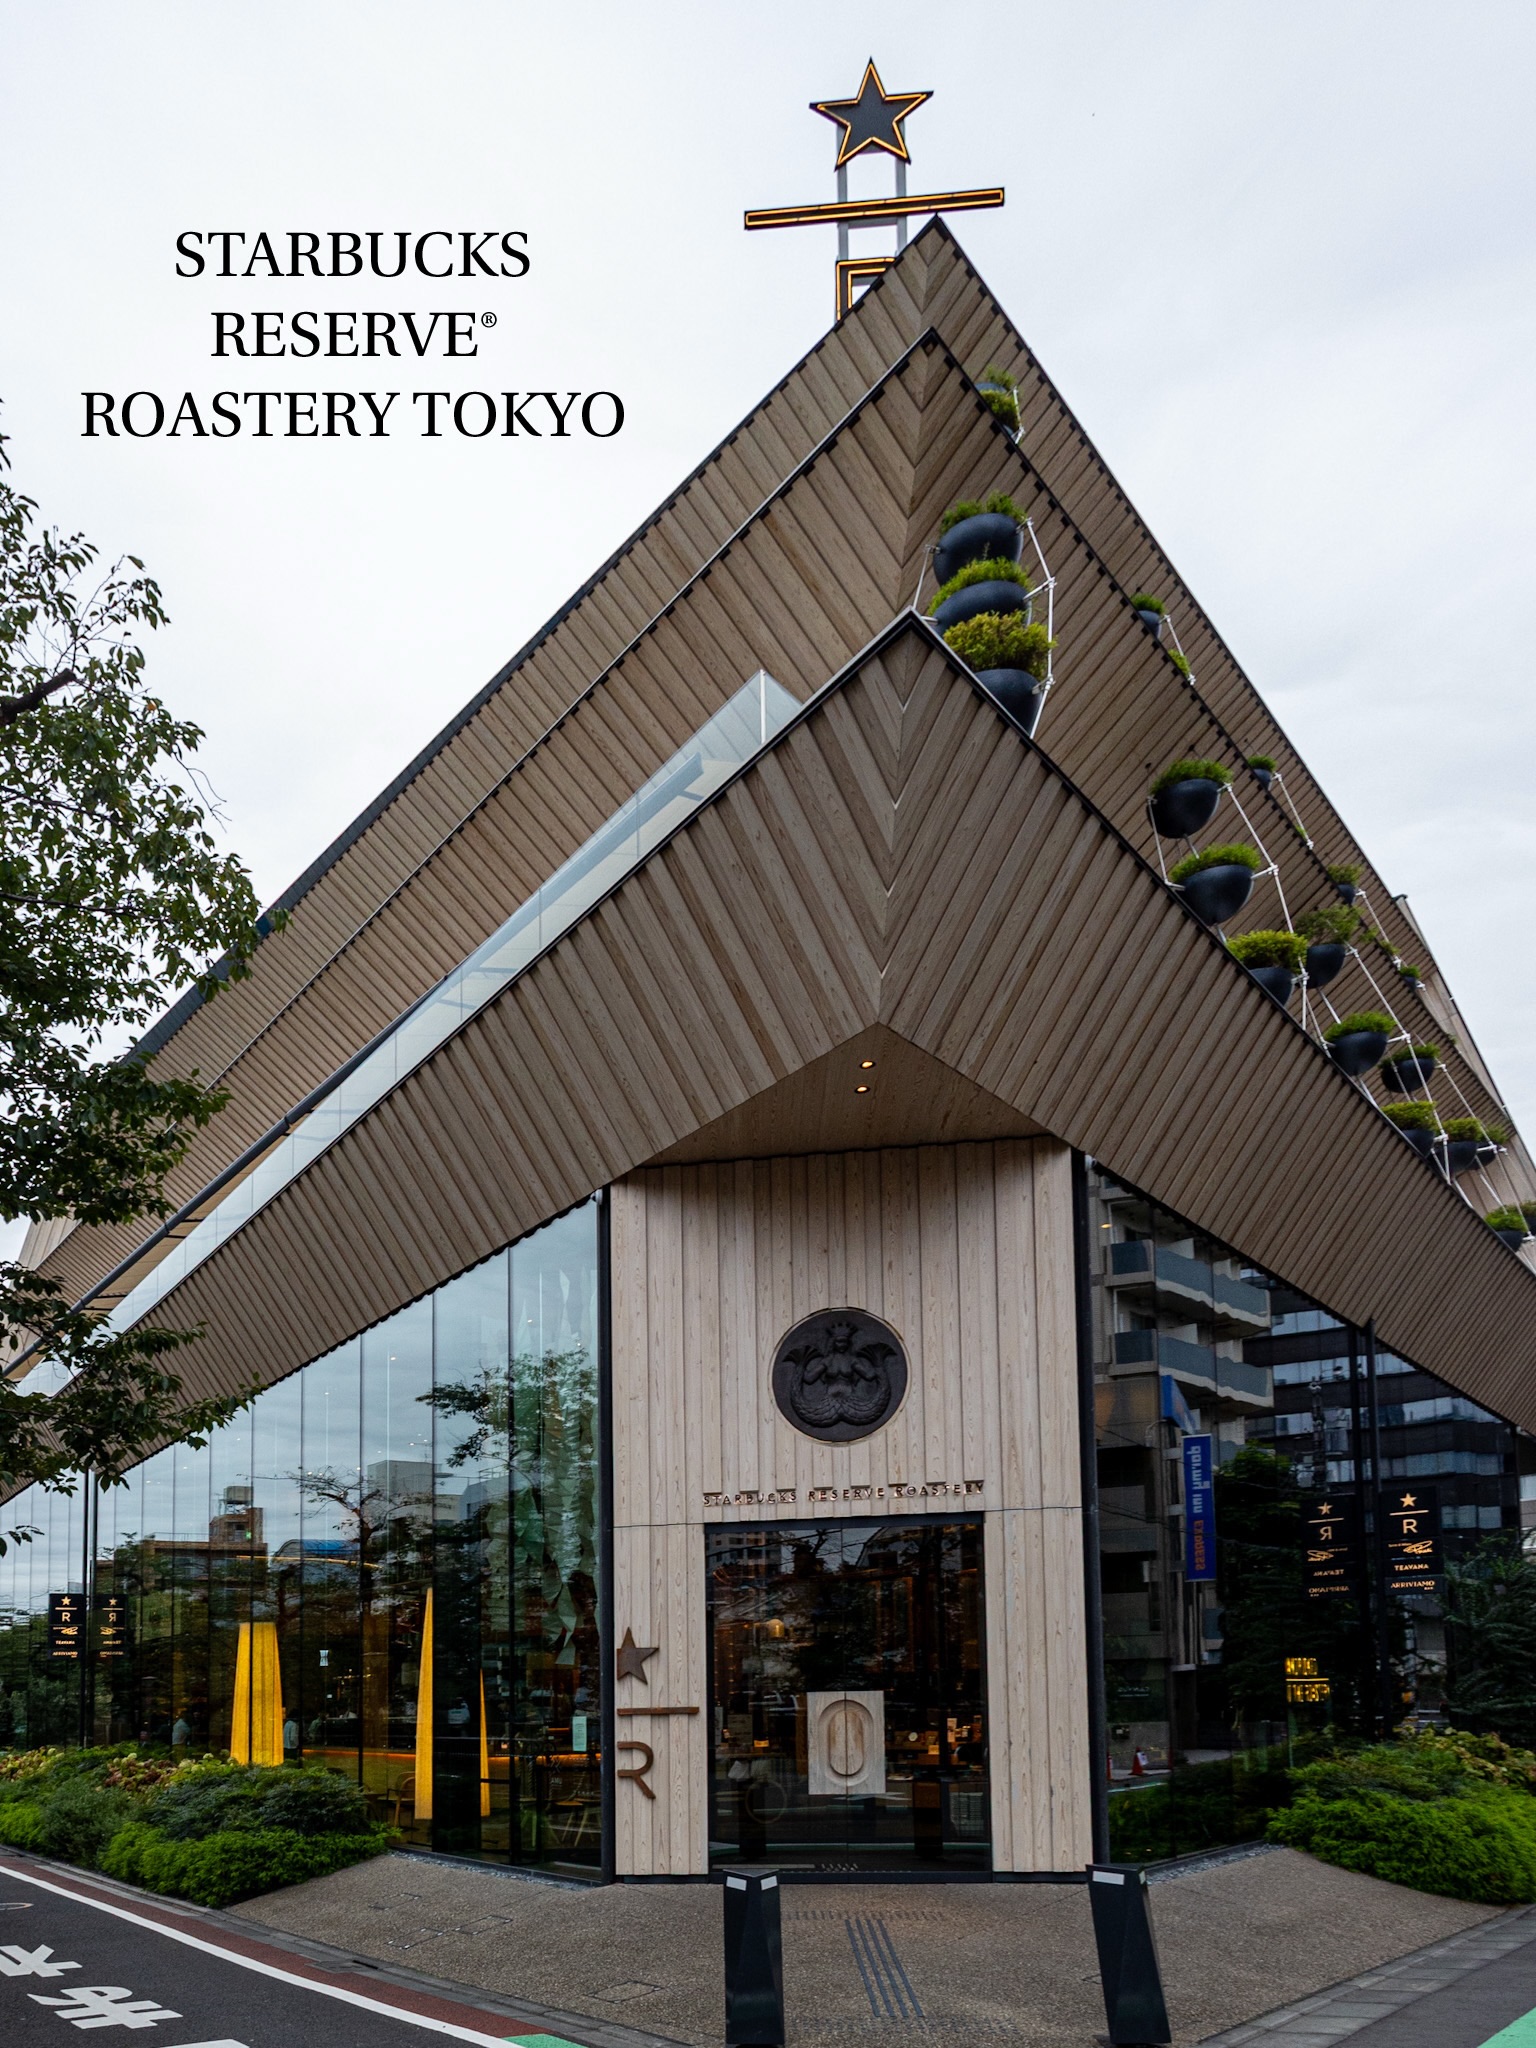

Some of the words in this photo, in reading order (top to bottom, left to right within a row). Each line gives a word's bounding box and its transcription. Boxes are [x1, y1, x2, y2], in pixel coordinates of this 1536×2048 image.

[703, 1491, 797, 1507] STARBUCKS
[808, 1487, 885, 1501] RESERVE
[895, 1482, 985, 1497] ROASTERY
[1403, 1519, 1418, 1534] R
[61, 1612, 71, 1622] R
